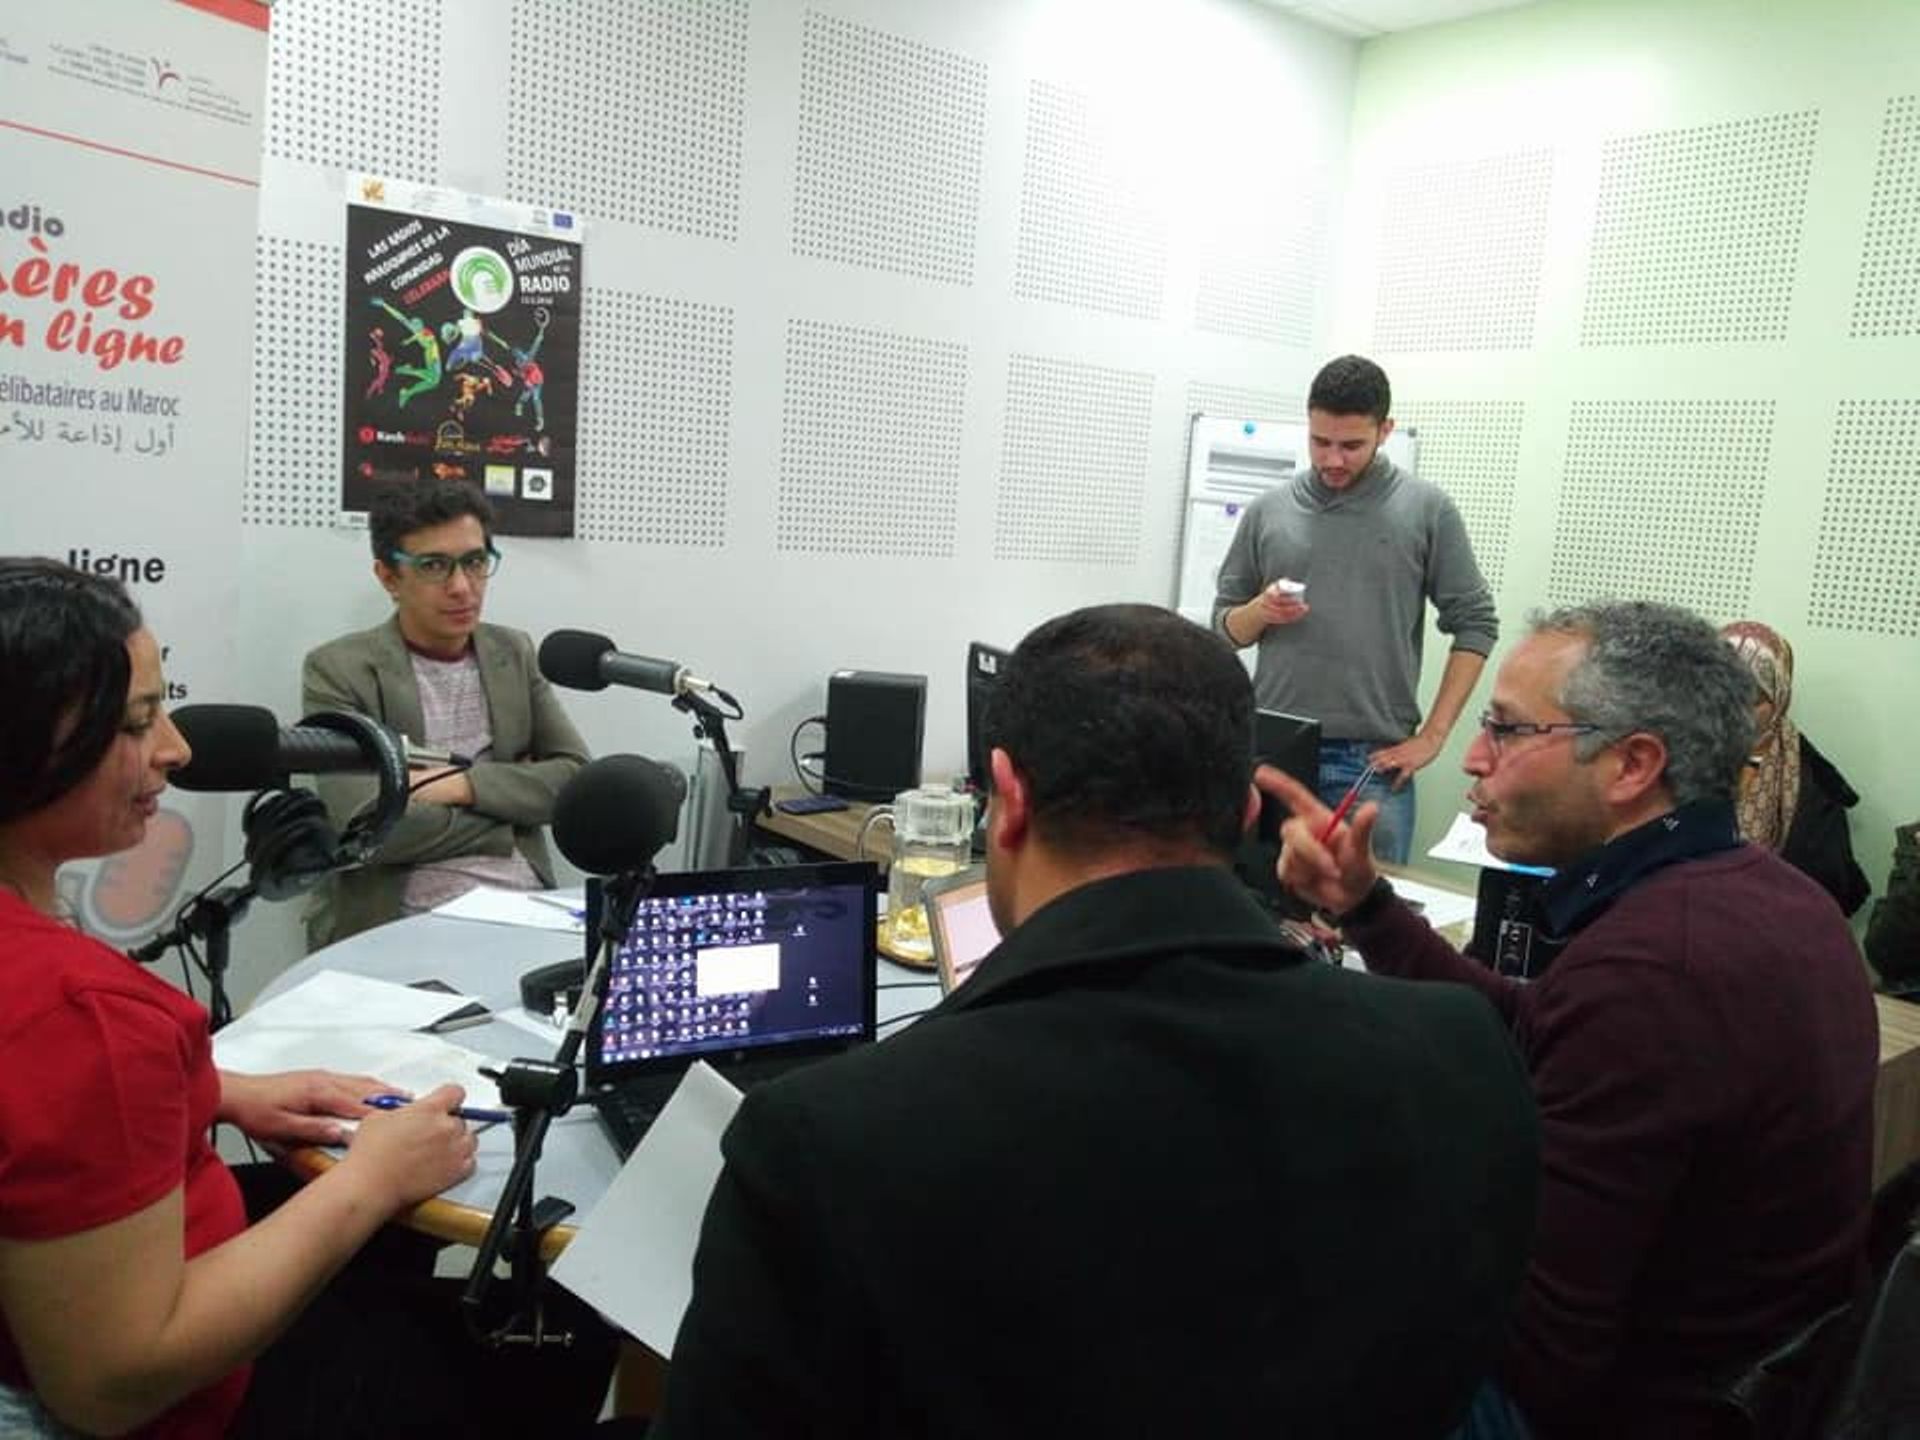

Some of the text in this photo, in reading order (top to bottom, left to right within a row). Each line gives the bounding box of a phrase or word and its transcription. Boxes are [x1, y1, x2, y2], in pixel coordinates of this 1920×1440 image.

[0, 205, 64, 237] dio
[434, 226, 451, 240] LA
[367, 240, 389, 259] LAS
[514, 246, 573, 272] MUNDIAL
[0, 236, 155, 320] ères
[519, 275, 570, 293] RADIO
[45, 310, 185, 371] ligne
[99, 390, 123, 412] au
[127, 388, 181, 417] Maroc
[58, 421, 122, 453] إذاعة
[134, 422, 175, 455] أول
